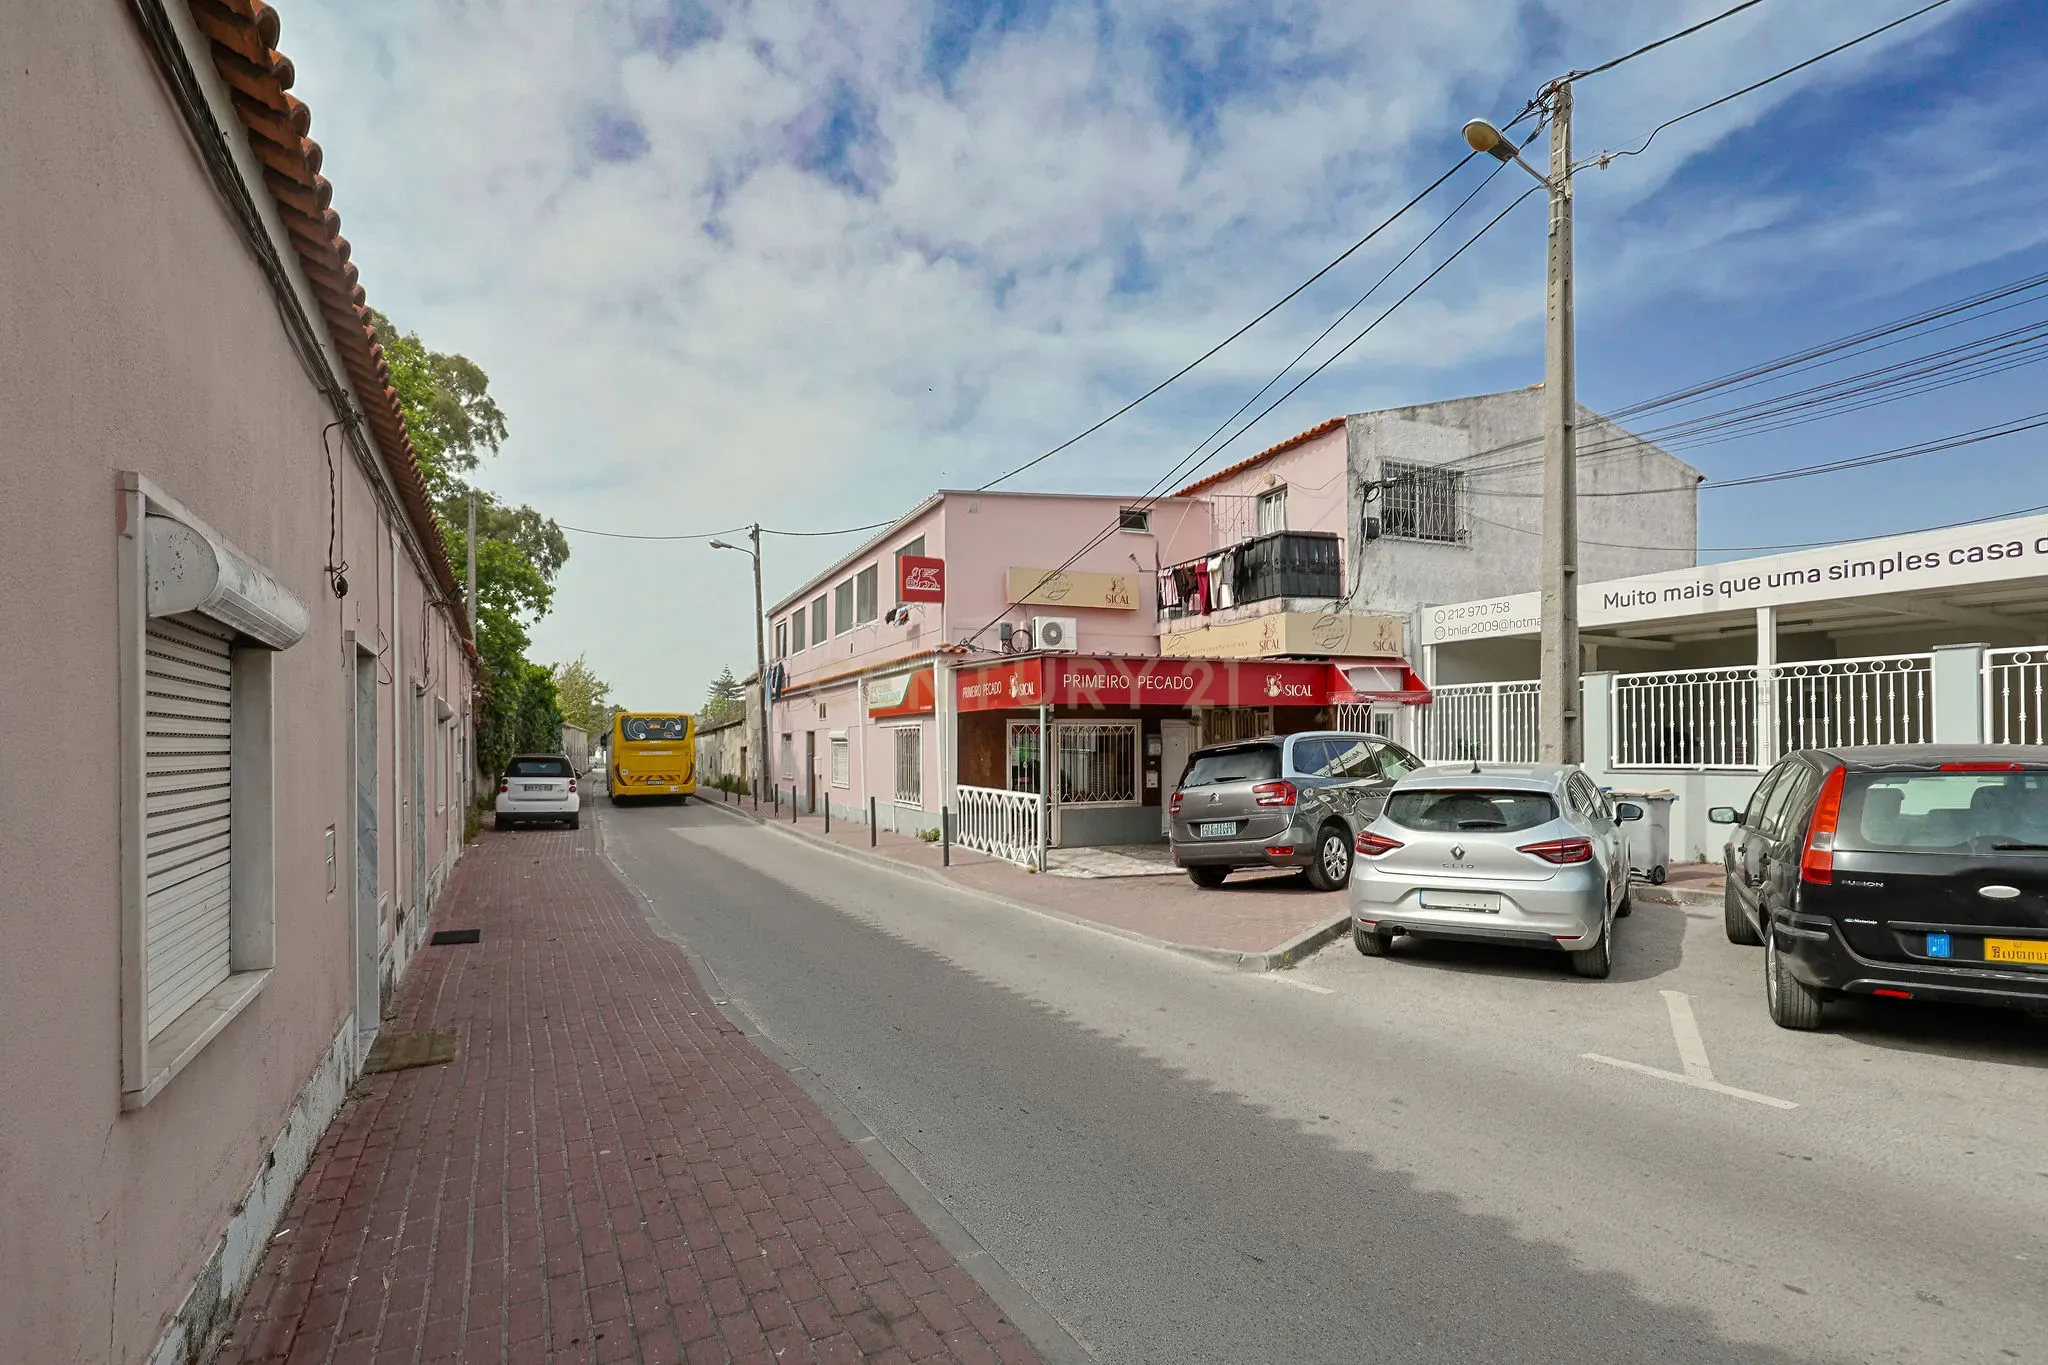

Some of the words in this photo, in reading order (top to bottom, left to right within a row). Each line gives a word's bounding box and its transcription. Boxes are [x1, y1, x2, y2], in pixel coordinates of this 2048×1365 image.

[1603, 589, 1657, 610] Muito
[1663, 580, 1714, 602] mais
[1719, 575, 1761, 598] que
[1767, 567, 1821, 588] uma
[1828, 551, 1941, 580] simples
[1948, 540, 2023, 566] casa
[1105, 594, 1131, 605] SICAL
[1447, 607, 1465, 620] 212
[1467, 604, 1487, 617] 970
[1490, 601, 1510, 614] 758
[1447, 617, 1541, 637] bnlar2009@hotma
[1259, 638, 1281, 652] SICAL
[1373, 640, 1399, 652] SICAL
[983, 680, 1002, 696] PECADO
[1018, 681, 1035, 696] SICAL
[1063, 673, 1130, 689] PRIMEIRO
[1137, 675, 1194, 690] PECADO
[1284, 684, 1313, 697] SICAL
